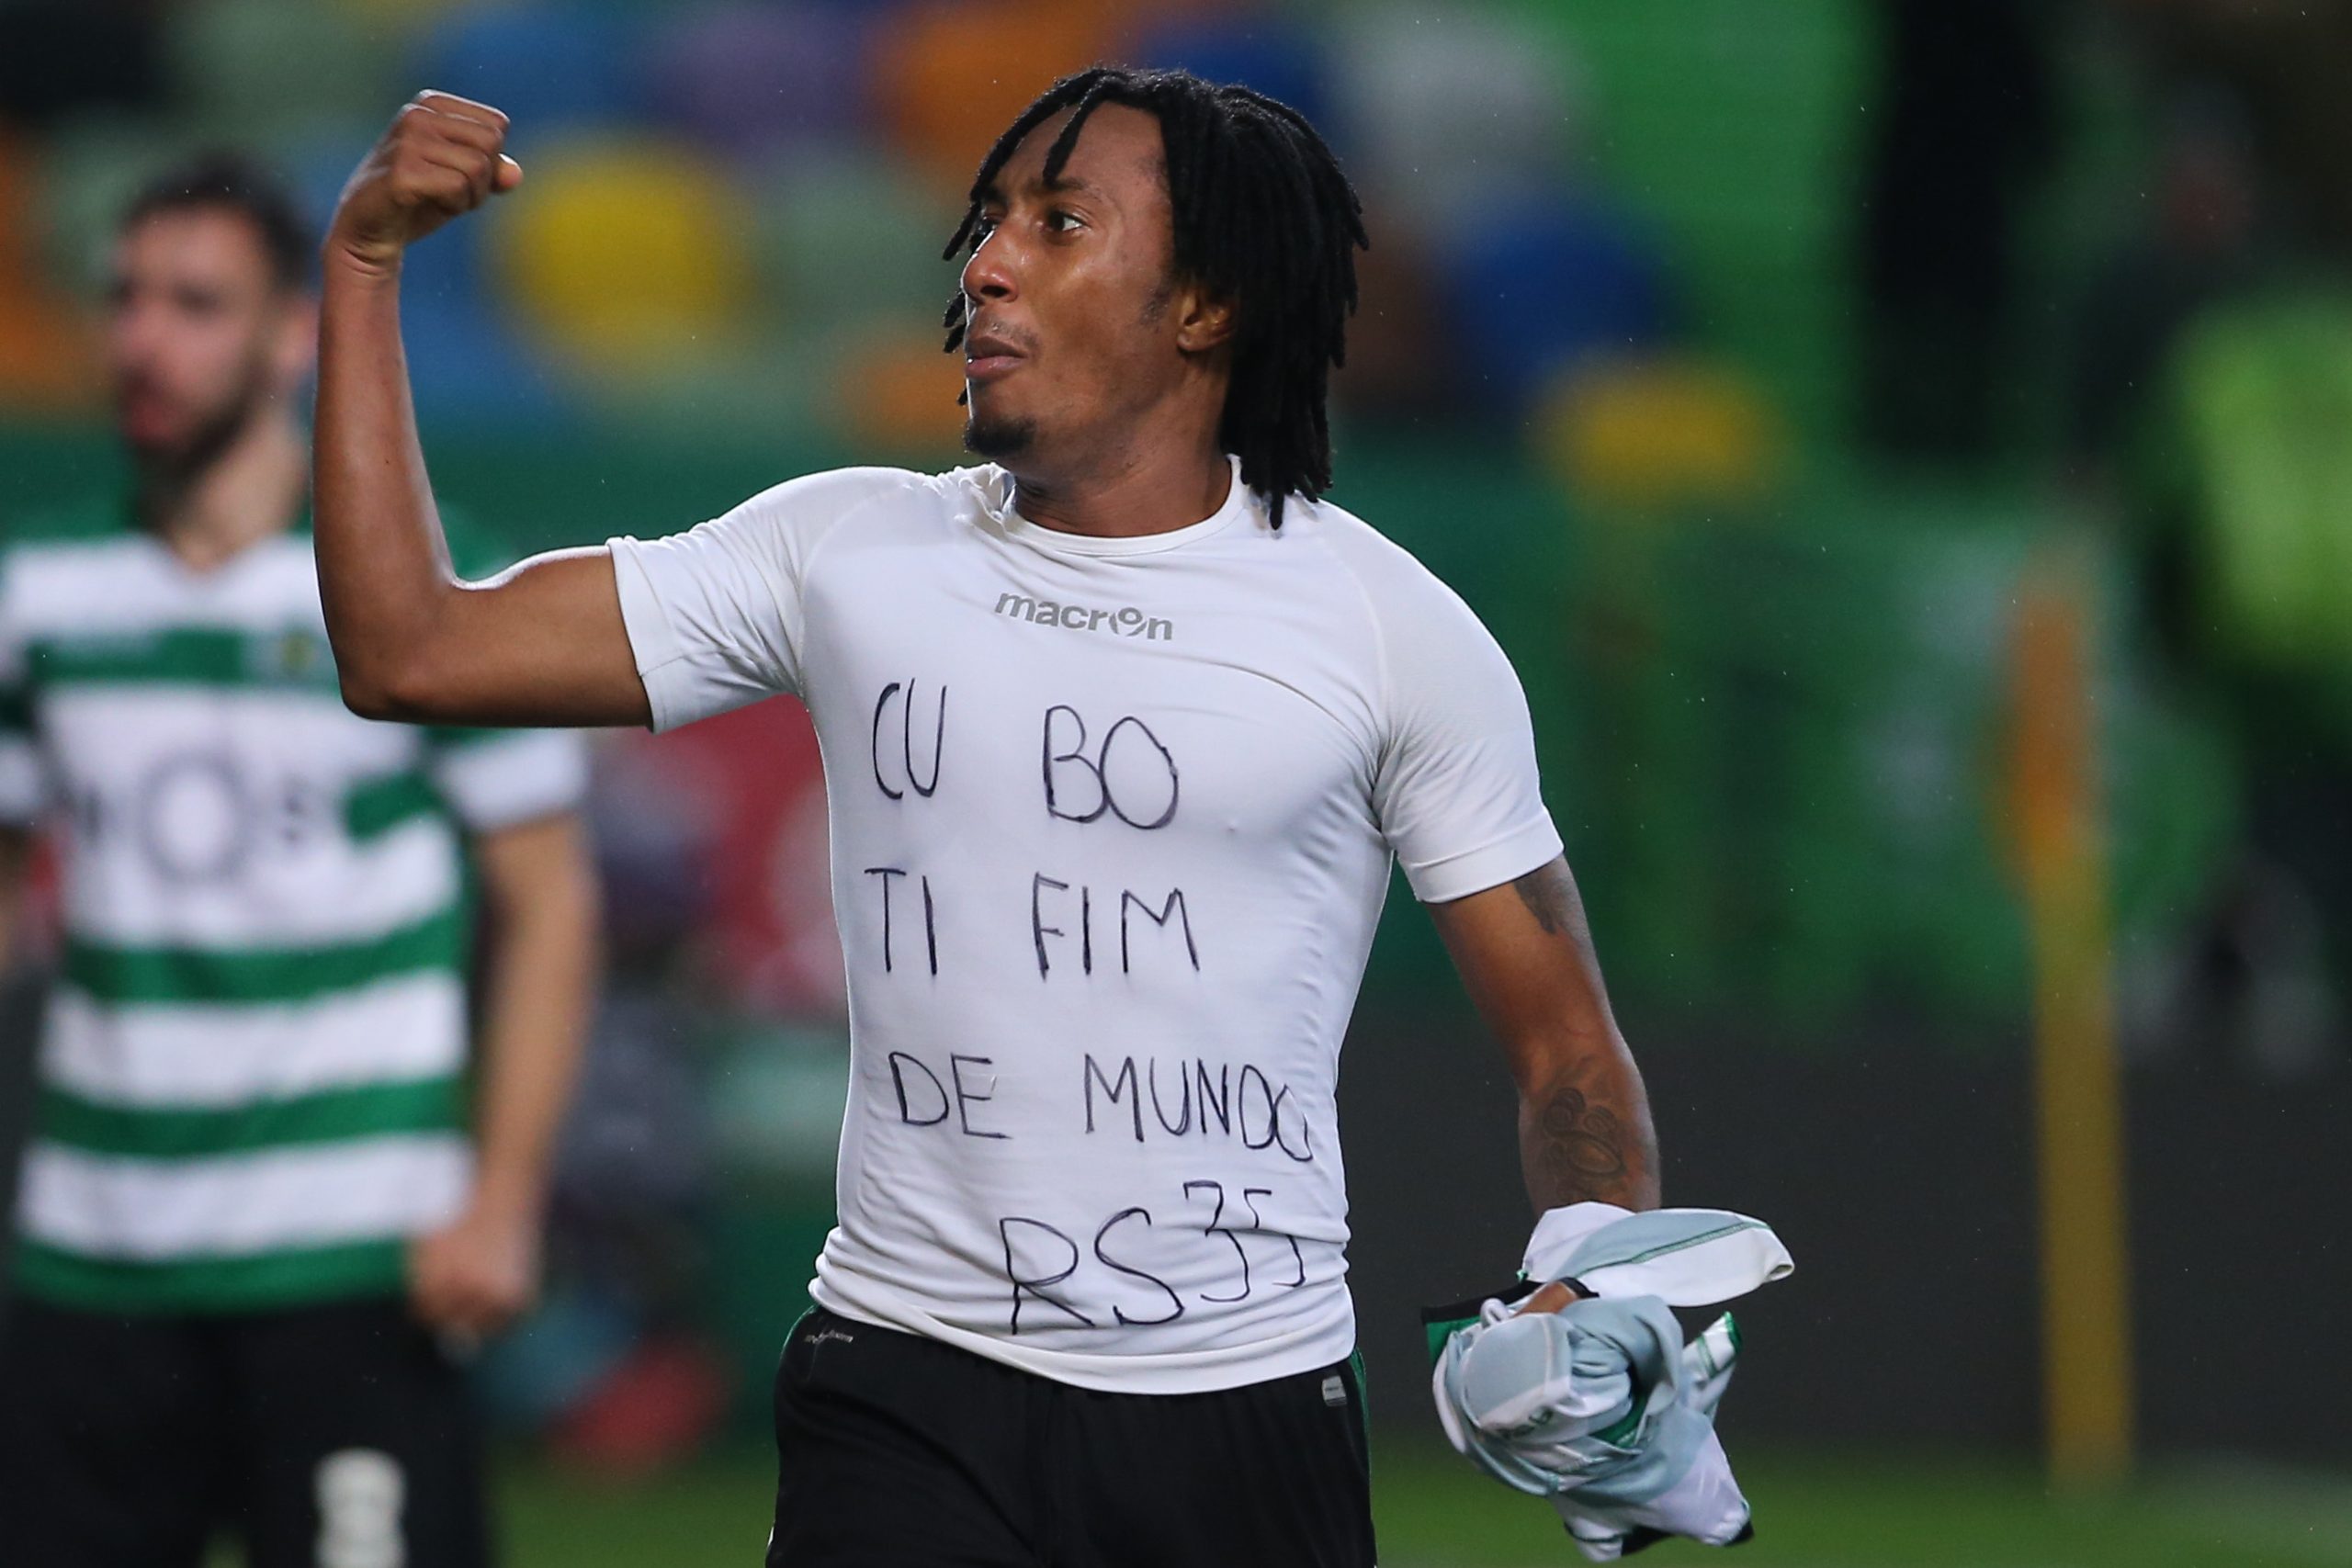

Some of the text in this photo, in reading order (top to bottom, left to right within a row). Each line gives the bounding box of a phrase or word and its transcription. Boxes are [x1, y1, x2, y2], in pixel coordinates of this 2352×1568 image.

[994, 592, 1173, 641] macron
[873, 678, 1179, 829] CU BO
[864, 868, 1200, 981] TI FIM
[889, 1051, 1314, 1162] DE MUNDO
